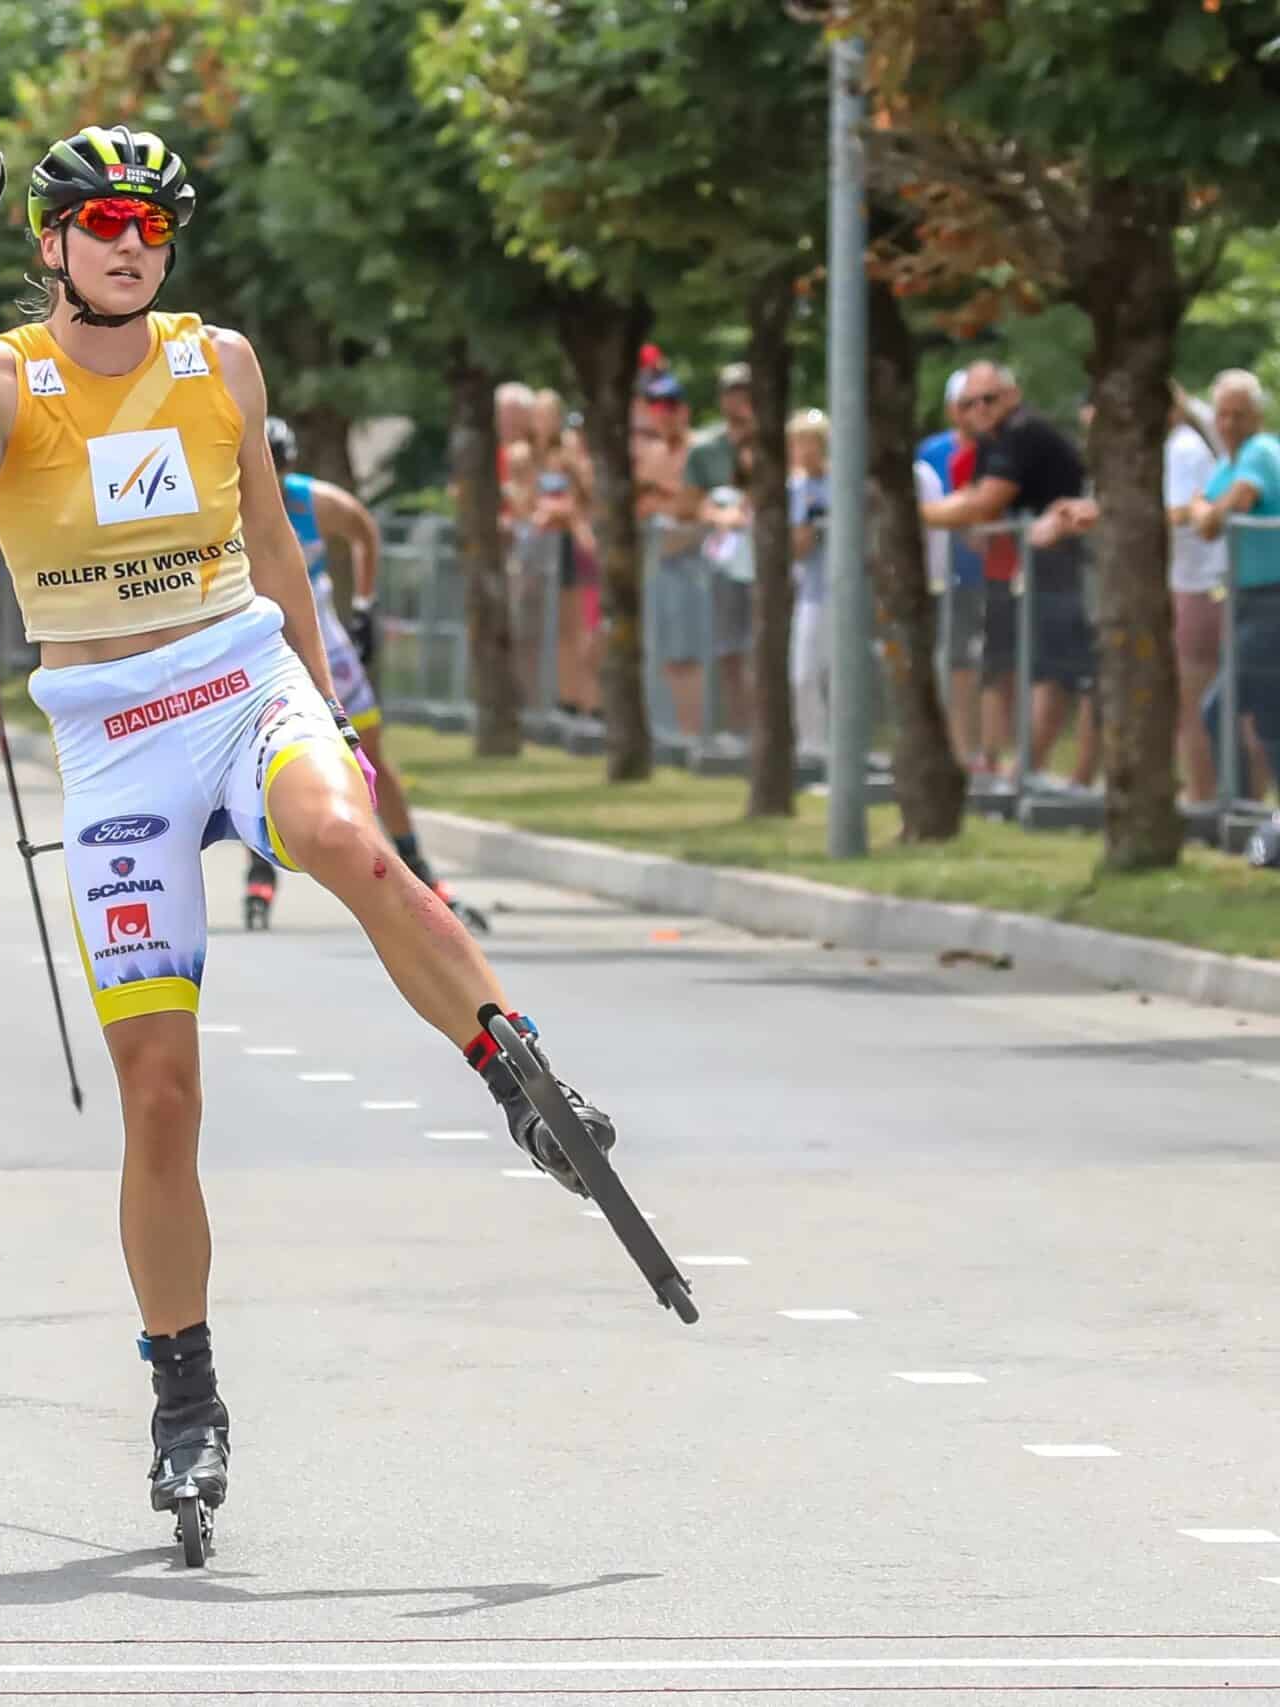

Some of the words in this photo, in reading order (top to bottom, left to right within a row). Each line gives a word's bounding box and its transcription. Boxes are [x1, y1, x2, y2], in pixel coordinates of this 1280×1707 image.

[37, 565, 108, 587] ROLLER
[113, 559, 147, 579] SKI
[153, 545, 221, 571] WORLD
[223, 539, 243, 554] CU
[118, 571, 196, 601] SENIOR
[107, 671, 248, 737] BAUHAUS
[94, 819, 153, 842] Ford
[87, 879, 165, 901] SCANIA
[94, 943, 146, 960] SVENSKA
[147, 940, 172, 951] SPEL
